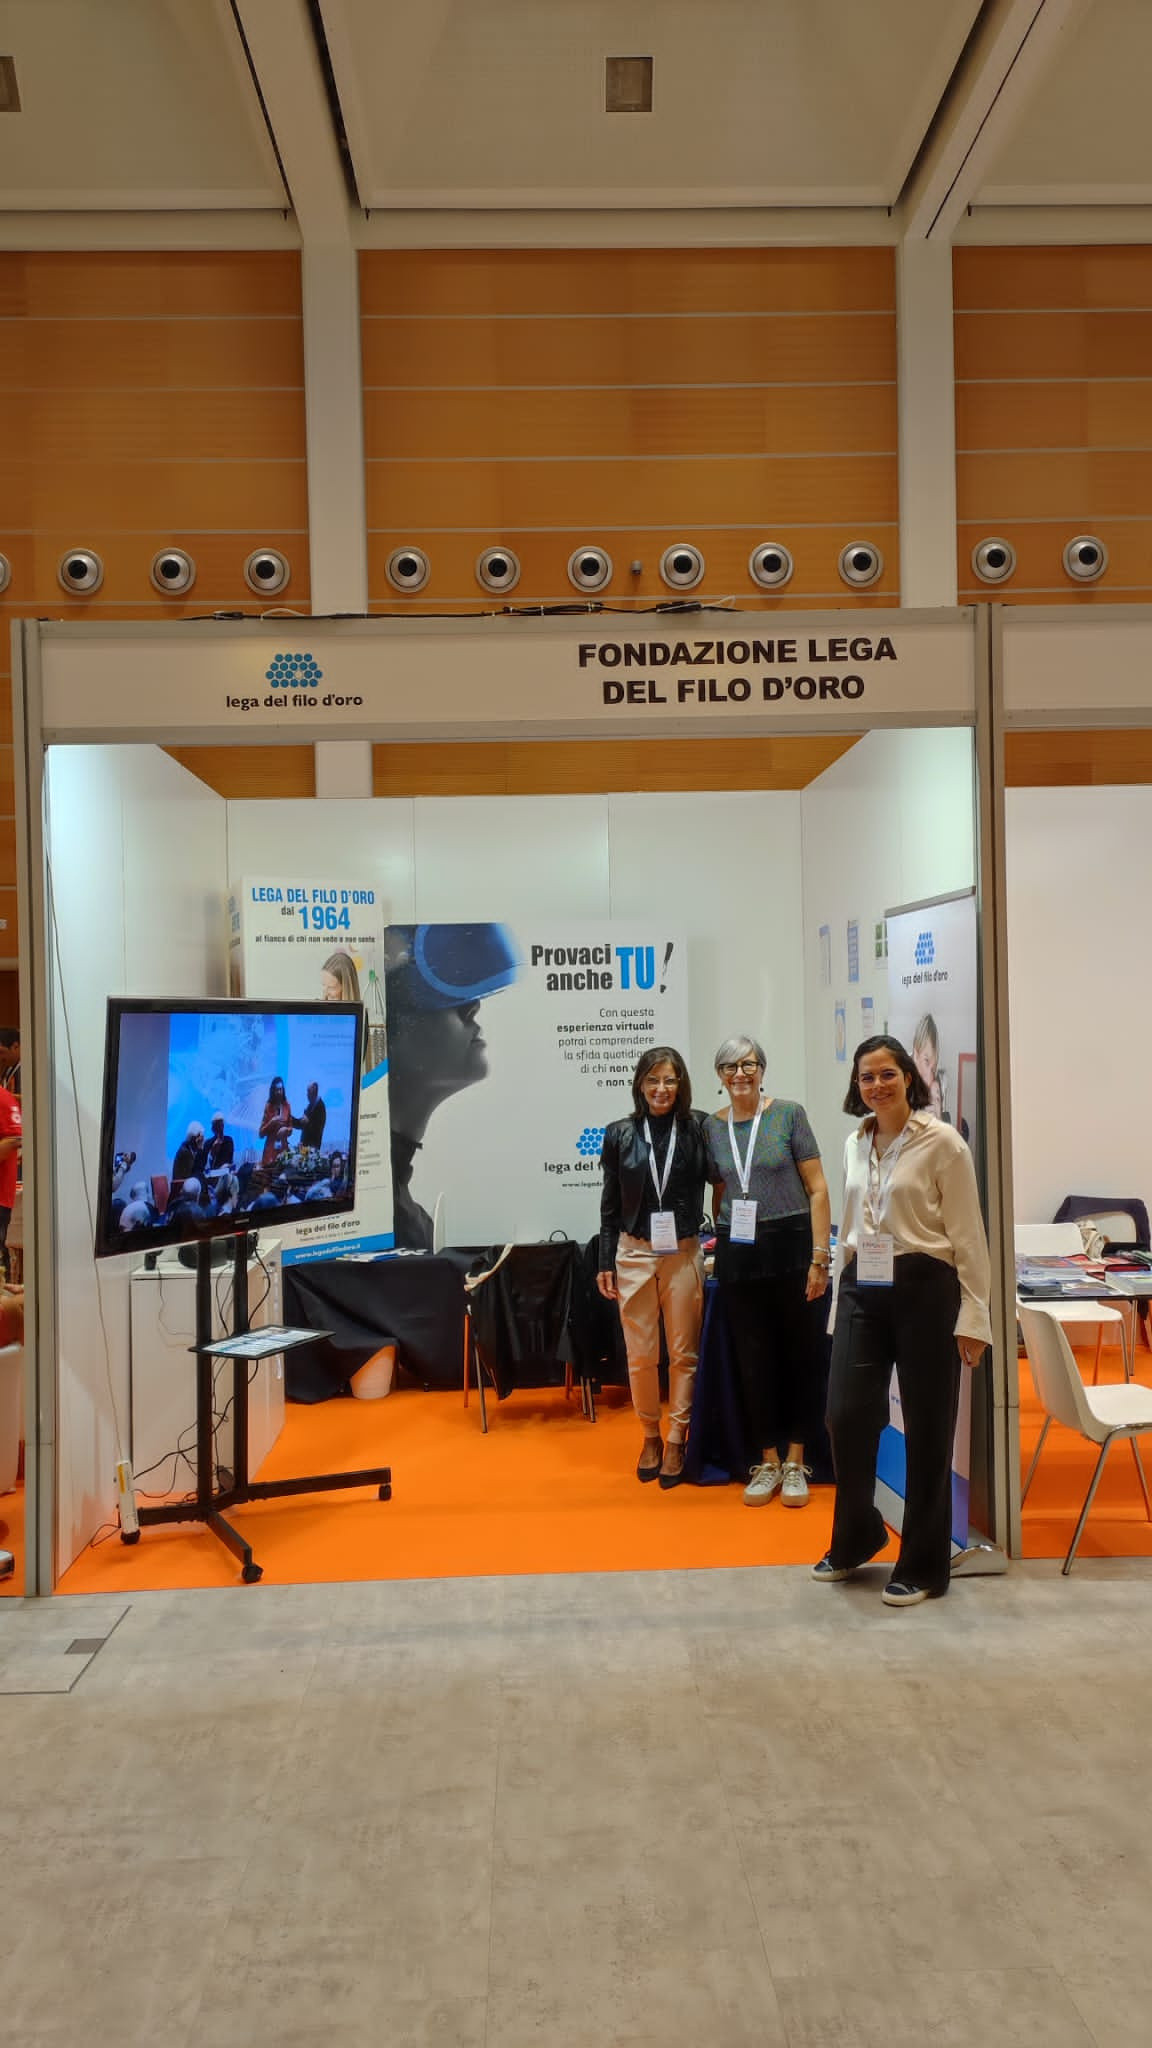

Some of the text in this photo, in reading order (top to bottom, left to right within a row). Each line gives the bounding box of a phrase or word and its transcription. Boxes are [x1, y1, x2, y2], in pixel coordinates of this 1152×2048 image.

[578, 637, 897, 667] FONDAZIONE LEGA
[603, 675, 865, 704] DEL FILO D’ORO
[226, 694, 364, 711] lega del filo d'oro
[252, 887, 375, 905] LEGA DEL FILO D'ORO
[281, 905, 351, 930] dal 1964
[264, 935, 286, 943] fianco
[531, 944, 611, 966] Provaci
[546, 969, 613, 991] anche
[913, 971, 923, 984] del
[600, 1008, 655, 1019] Con questa
[556, 1021, 655, 1033] esperienza virtuale
[558, 1035, 655, 1048] potrai comprendere
[564, 1048, 644, 1061] la sfida quotidia
[580, 1063, 590, 1074] di
[592, 1063, 607, 1073] chi
[609, 1065, 629, 1073] non
[606, 1079, 625, 1087] non
[544, 1162, 571, 1175] lega
[574, 1161, 594, 1171] del
[295, 1226, 313, 1236] lega
[314, 1223, 327, 1233] del
[327, 1221, 340, 1231] filo
